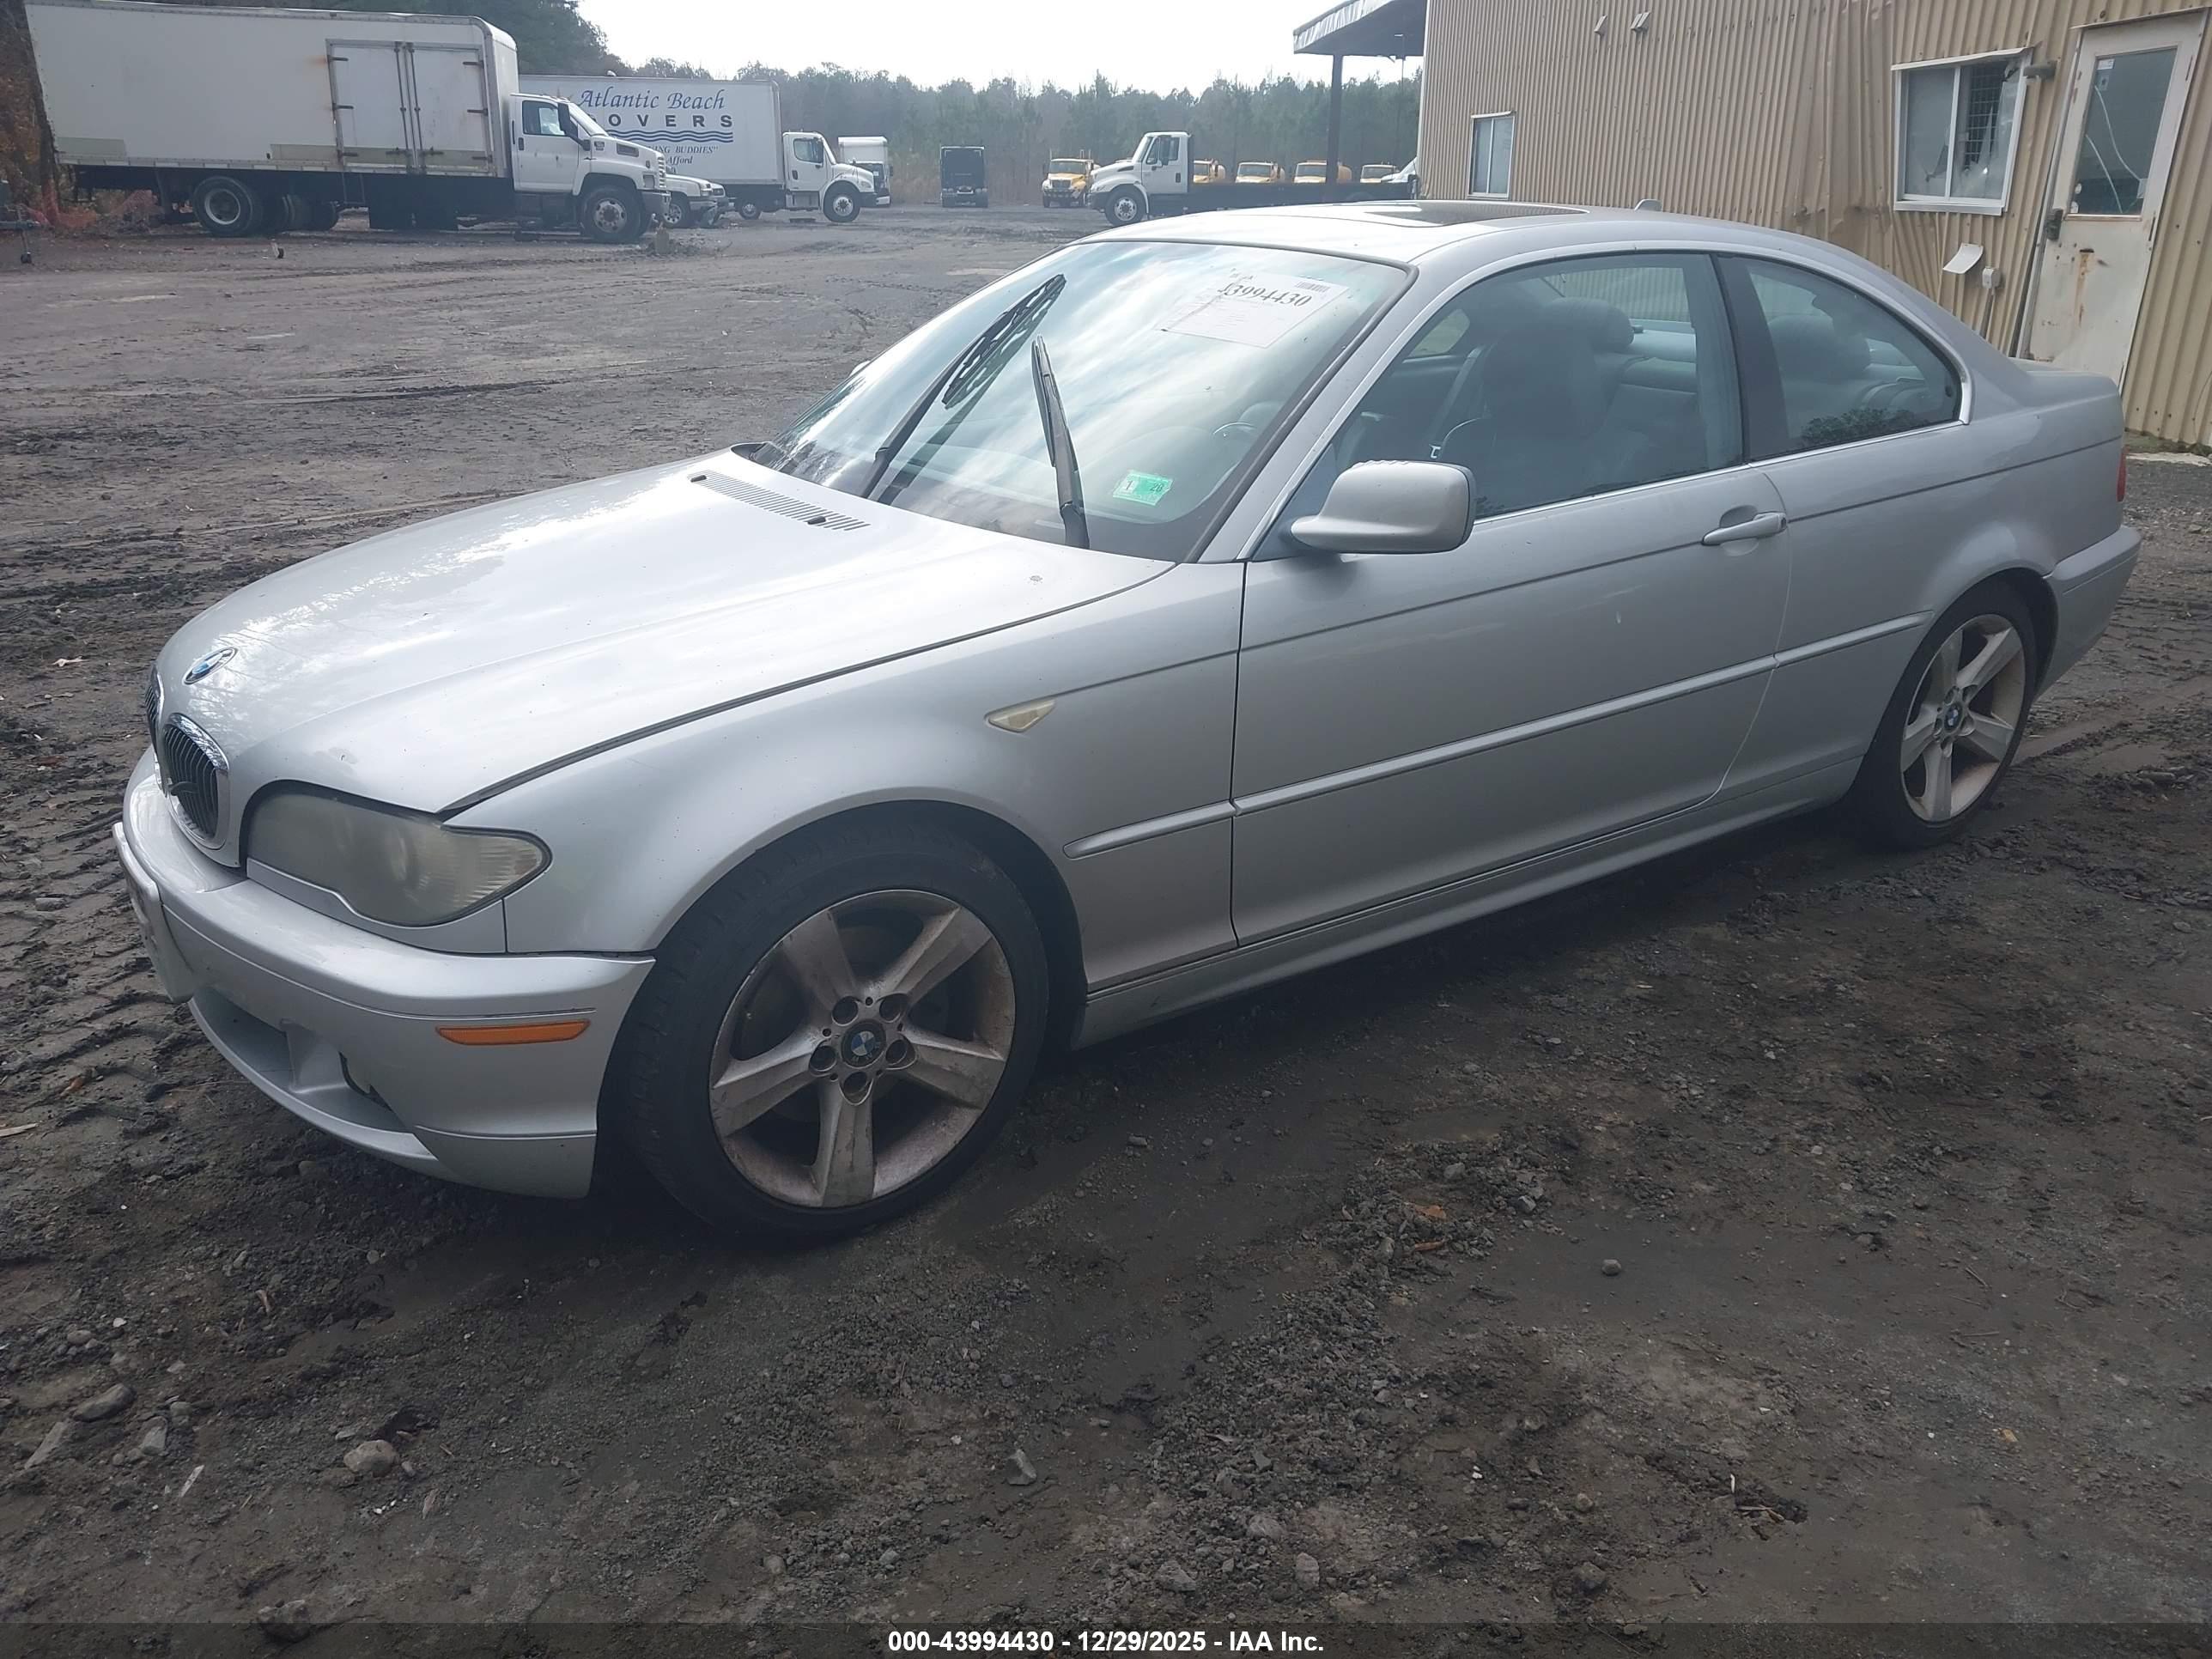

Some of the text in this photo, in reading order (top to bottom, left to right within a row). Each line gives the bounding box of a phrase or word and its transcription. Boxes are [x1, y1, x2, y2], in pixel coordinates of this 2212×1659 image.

[580, 86, 726, 110] Atlantic Beach
[592, 113, 733, 128] OVERS
